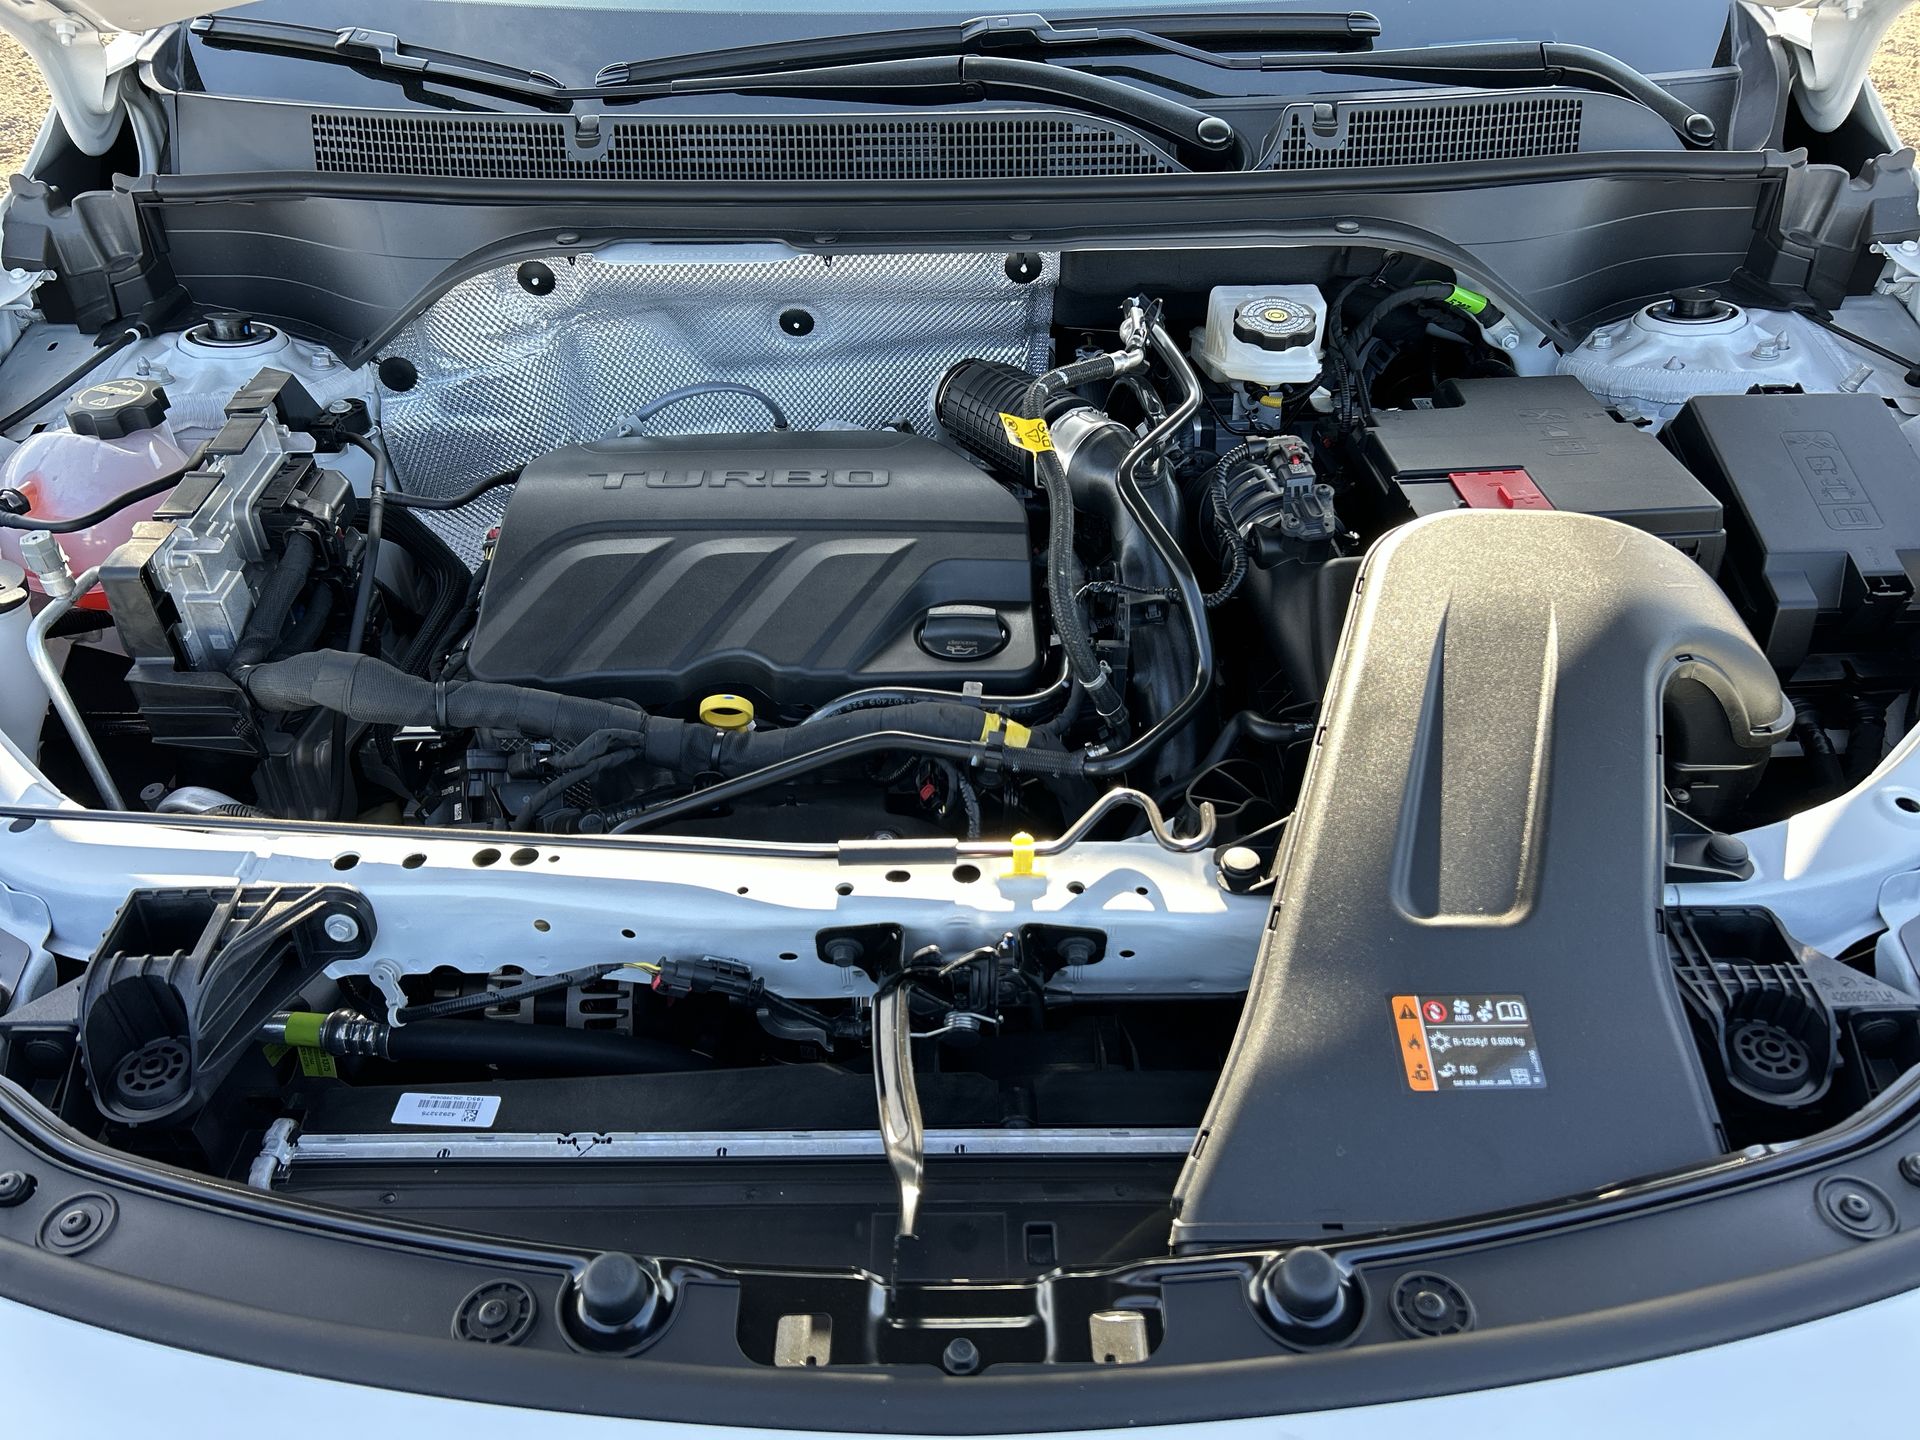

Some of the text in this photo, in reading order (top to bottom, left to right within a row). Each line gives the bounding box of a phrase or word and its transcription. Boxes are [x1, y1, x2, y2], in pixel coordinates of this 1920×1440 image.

[588, 468, 889, 489] TURBO
[1454, 1014, 1474, 1022] AUTO
[1452, 1036, 1525, 1047] R-1234yf 0.600 kg
[1459, 1065, 1478, 1075] PAG
